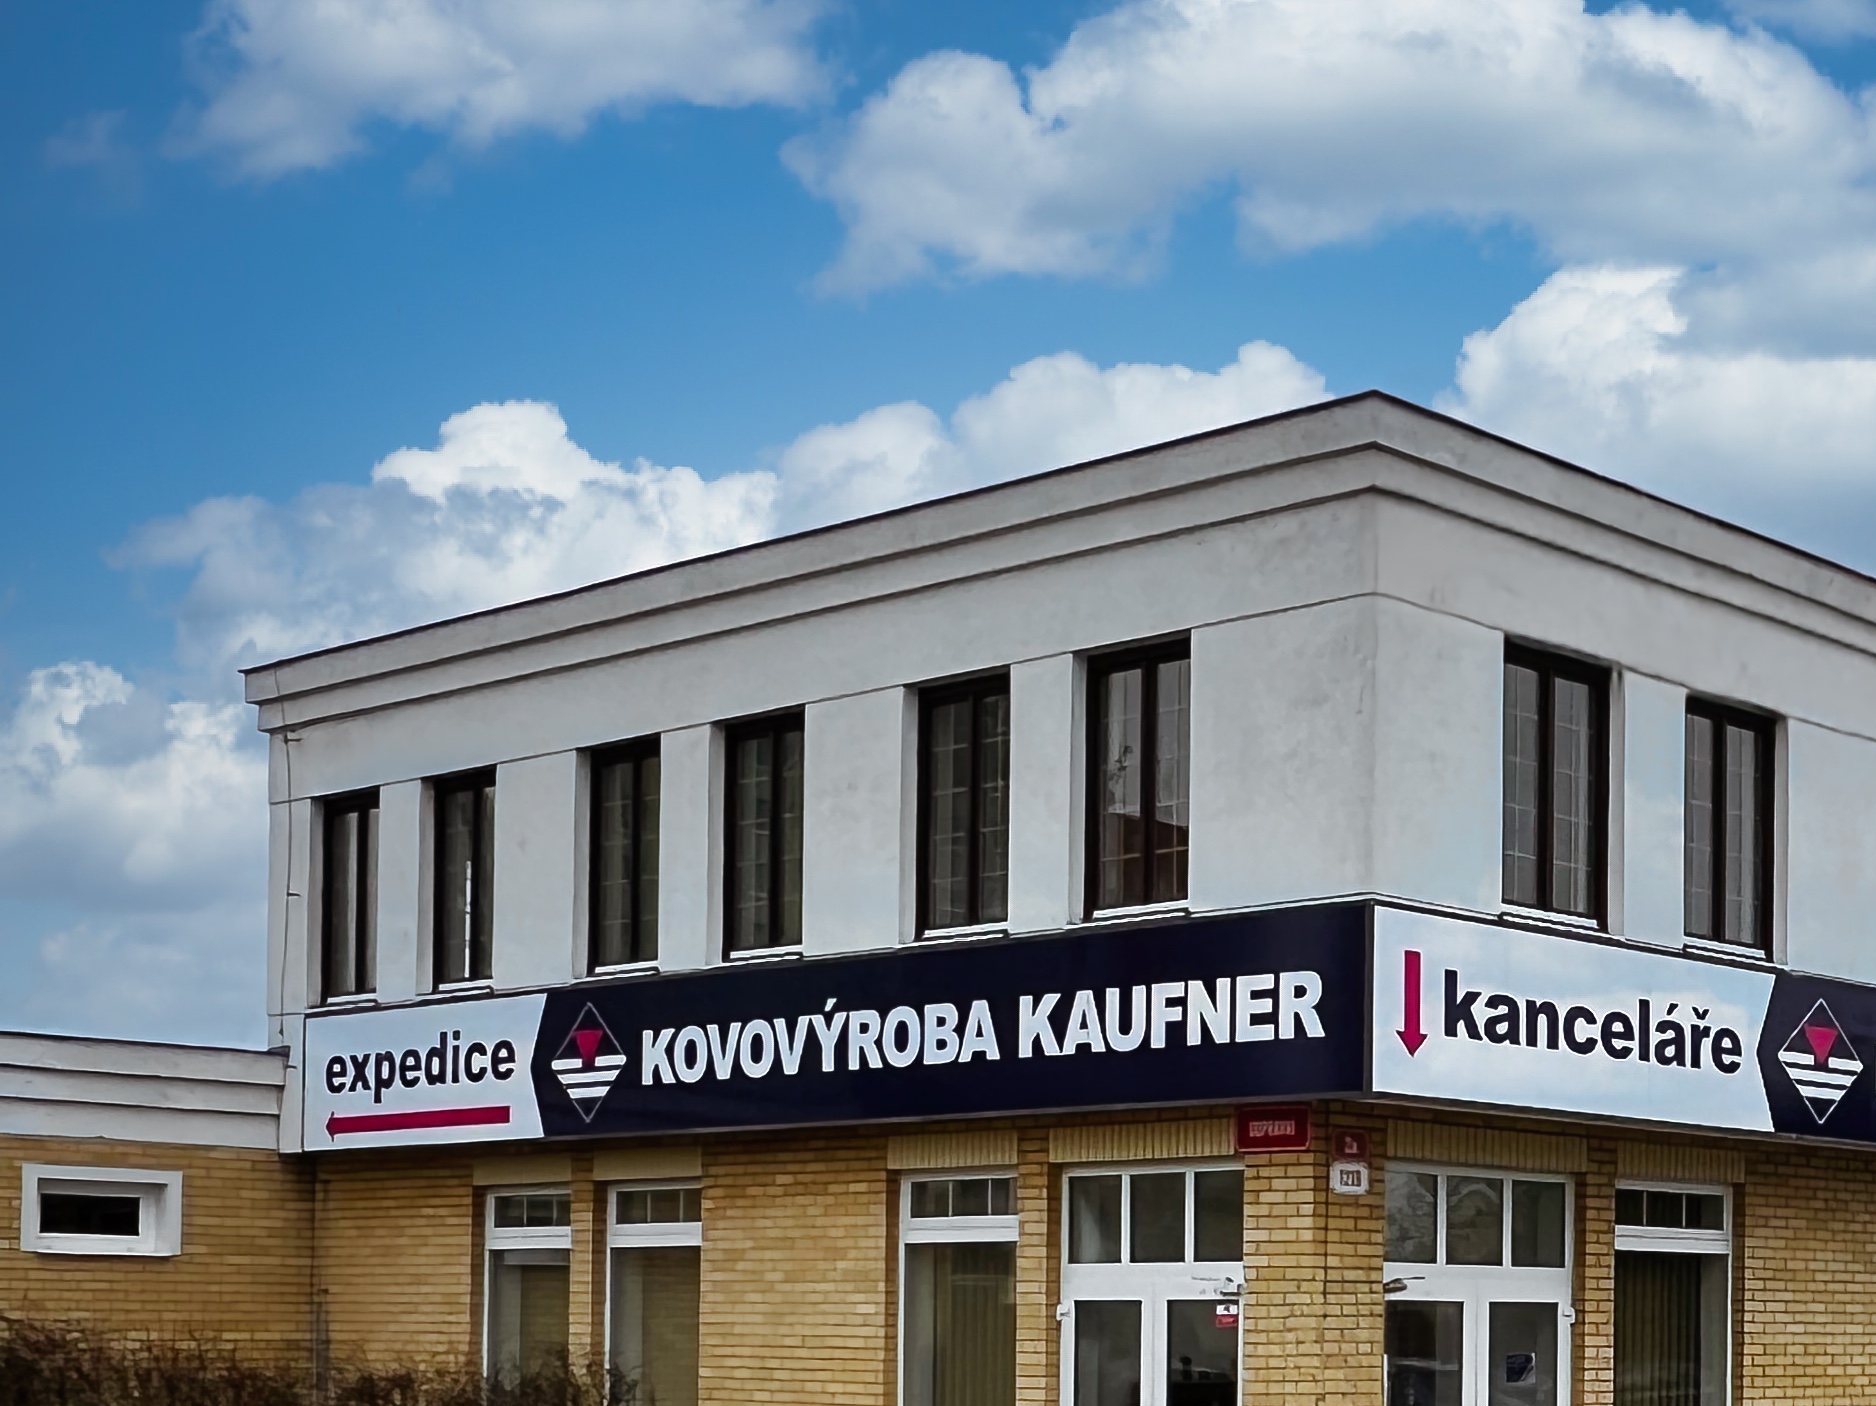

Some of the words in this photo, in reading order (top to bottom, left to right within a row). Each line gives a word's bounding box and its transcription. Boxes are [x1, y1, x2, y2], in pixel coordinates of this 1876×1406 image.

[324, 1029, 518, 1104] expedice
[640, 997, 1002, 1087] KOVOVÝROBA
[1018, 970, 1326, 1060] KAUFNER
[1443, 967, 1744, 1076] kanceláře
